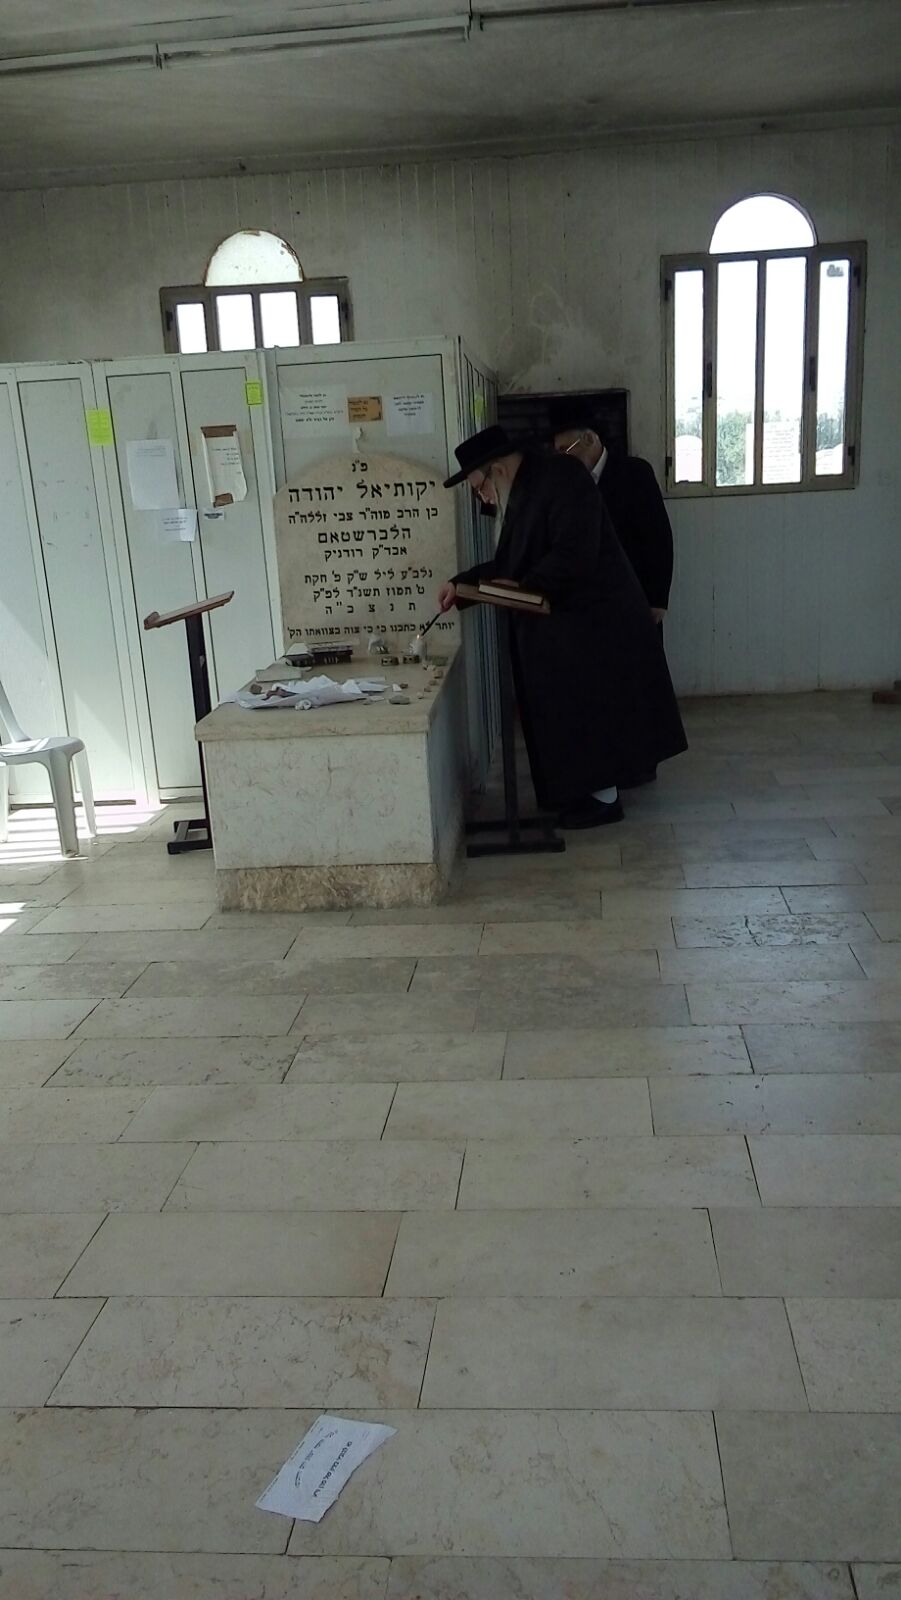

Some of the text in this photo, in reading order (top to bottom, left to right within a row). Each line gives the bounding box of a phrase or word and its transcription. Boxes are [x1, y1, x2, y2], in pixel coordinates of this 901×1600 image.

[351, 459, 369, 472] פ"נ
[288, 479, 436, 503] יקותיאל יהודה
[333, 511, 353, 522] צבי
[358, 507, 390, 521] מוה"ר
[397, 508, 420, 519] הרב
[426, 506, 438, 520] בן
[317, 524, 411, 543] הלברשטאם
[324, 545, 408, 562] אבד"ק רודניק
[304, 572, 327, 584] חקת
[347, 570, 368, 585] ש"ק
[374, 568, 395, 580] ליל
[313, 587, 340, 602] לפ"ק
[386, 587, 412, 595] תמוז
[408, 602, 416, 611] ת
[435, 622, 455, 631] יותר
